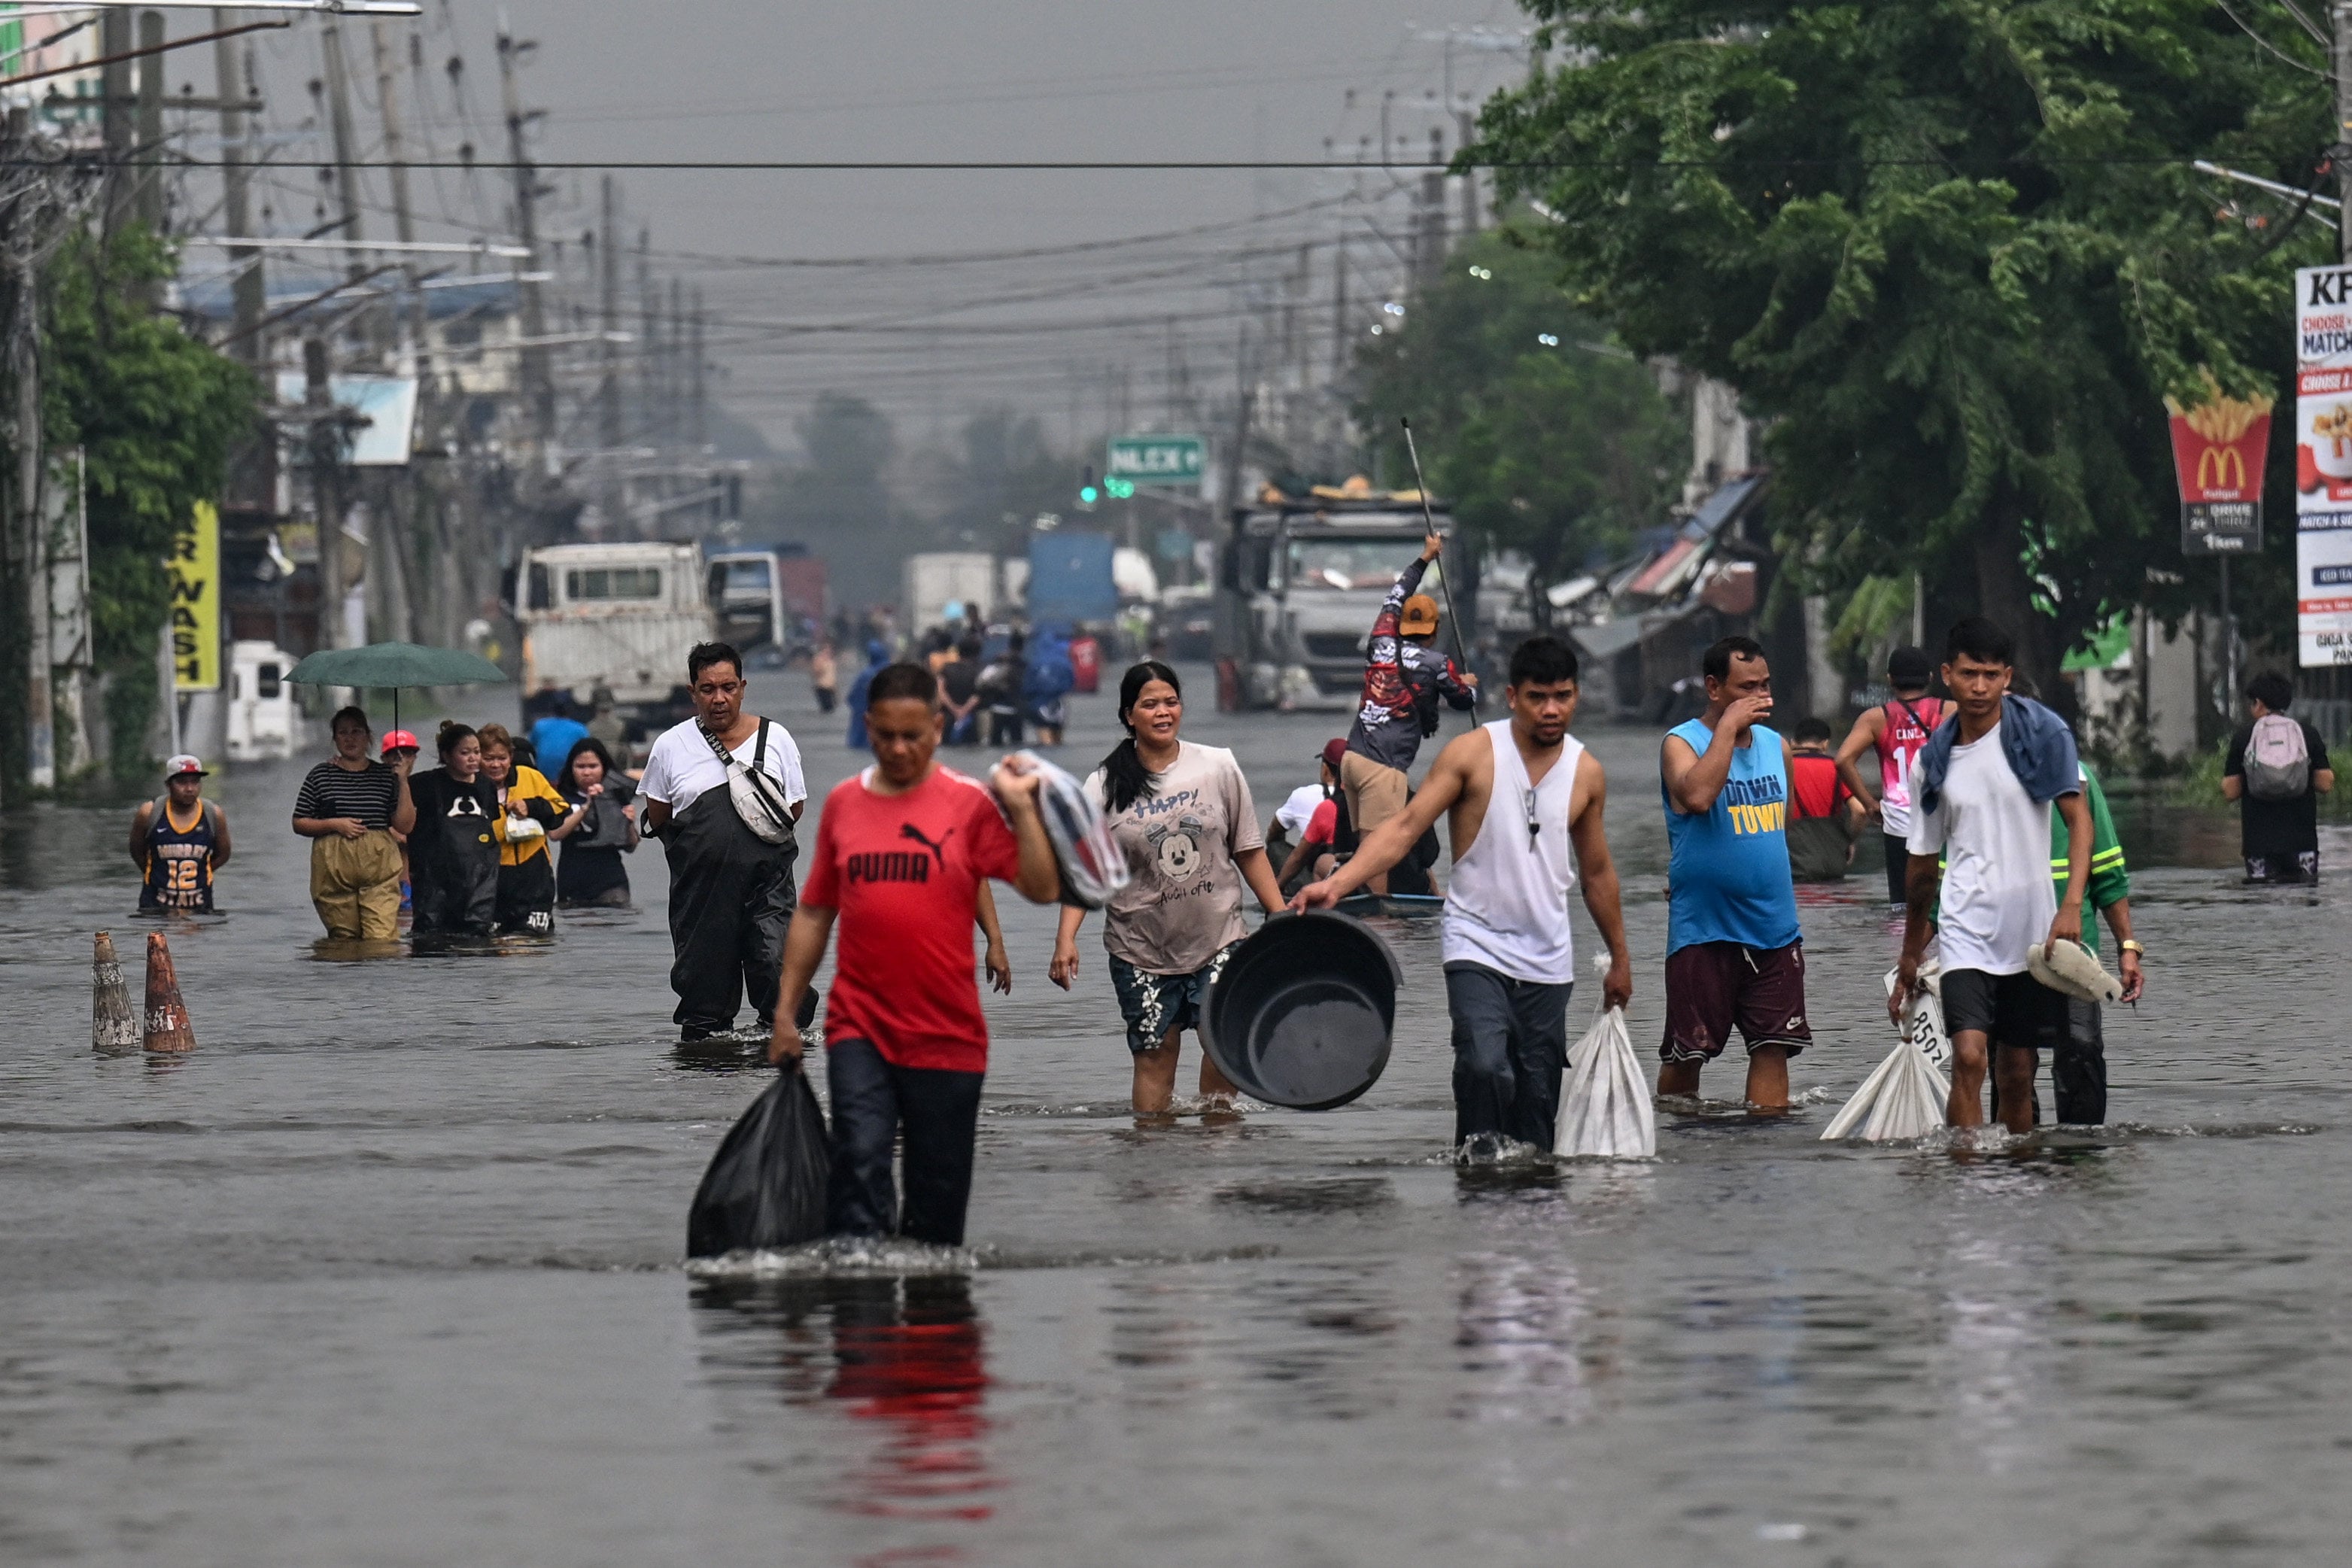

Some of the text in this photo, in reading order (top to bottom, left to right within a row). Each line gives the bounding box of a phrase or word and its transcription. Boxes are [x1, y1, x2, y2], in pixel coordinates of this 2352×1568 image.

[2302, 314, 2344, 332] CHOOSE
[2210, 503, 2252, 516] DRIVE
[1134, 789, 1199, 819] HAPPY
[1724, 773, 1782, 807] DOWN
[1728, 801, 1784, 835] TOWN
[156, 843, 208, 859] MURRAY
[166, 859, 199, 890] 12
[847, 852, 929, 886] PUMA
[156, 886, 205, 908] STATE
